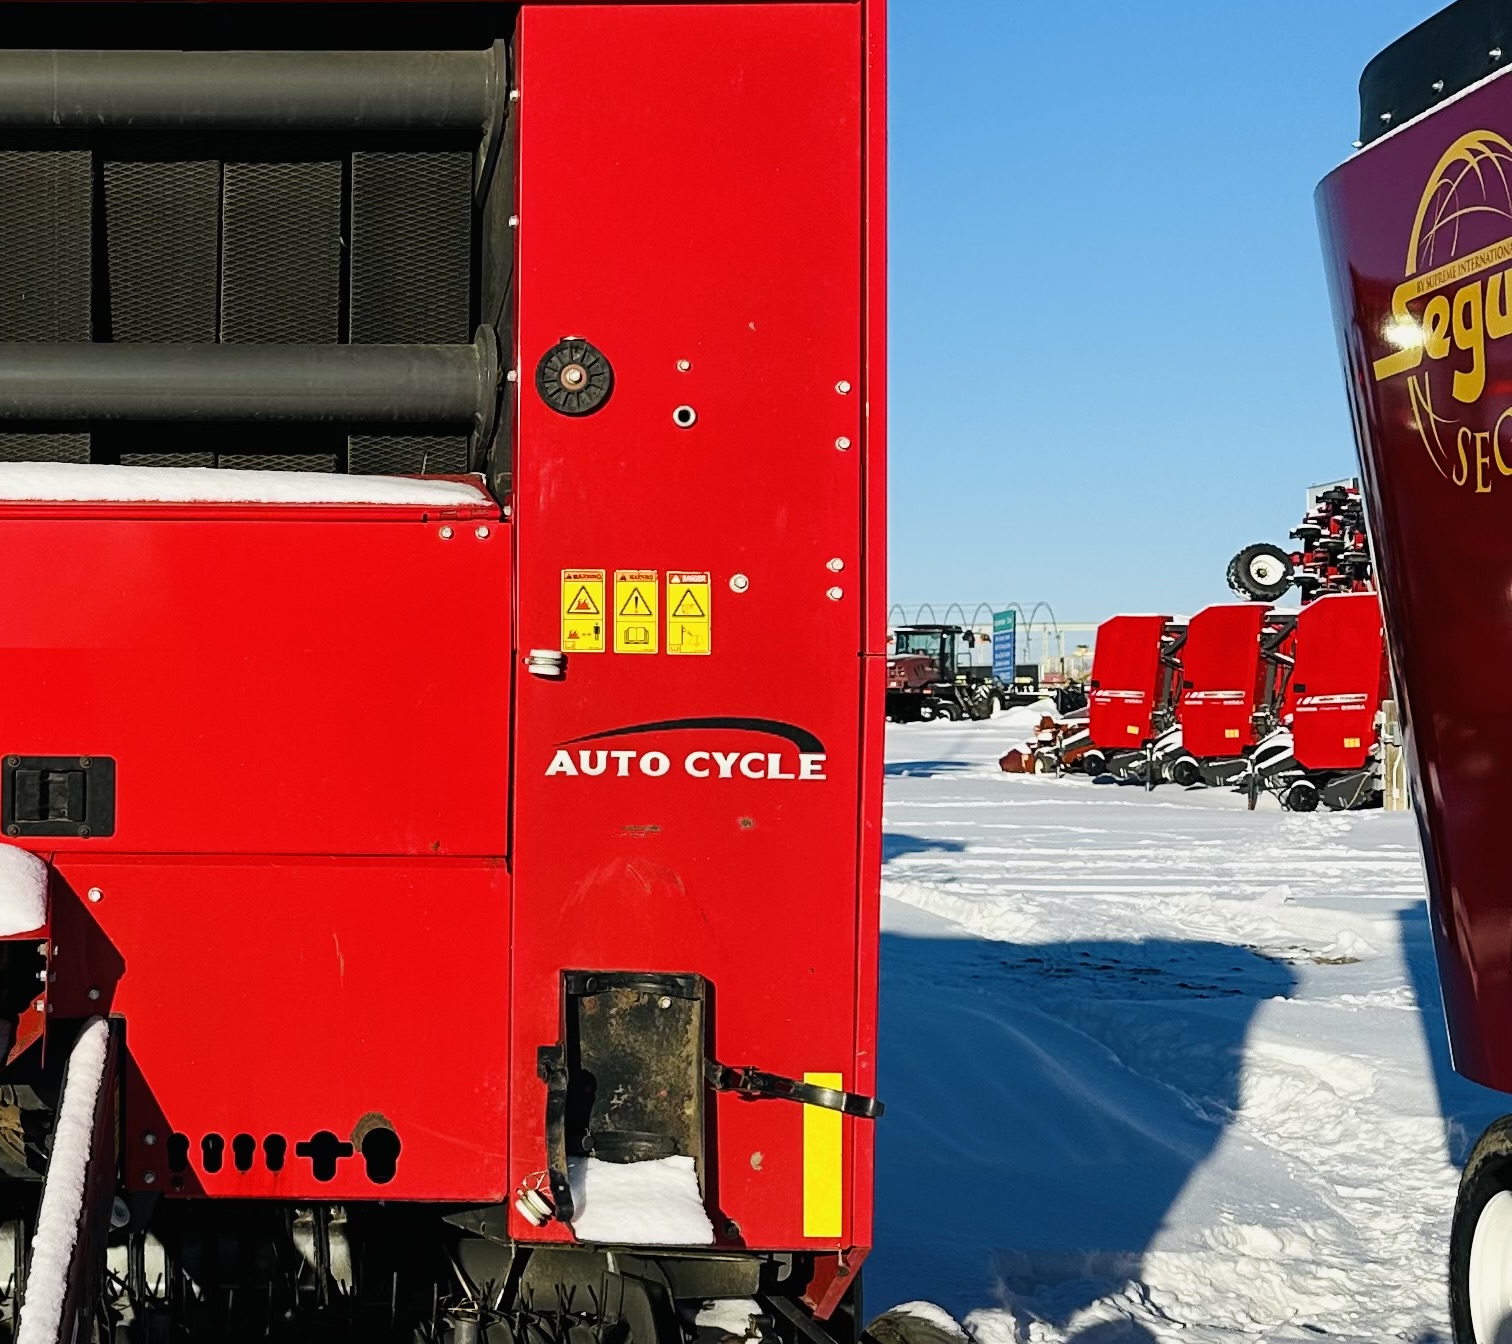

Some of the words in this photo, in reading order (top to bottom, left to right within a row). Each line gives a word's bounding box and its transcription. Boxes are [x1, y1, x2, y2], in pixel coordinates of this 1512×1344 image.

[1416, 279, 1426, 294] BY
[1425, 265, 1456, 289] SUPREME
[544, 749, 671, 777] AUTO
[684, 751, 827, 780] CYCLE
